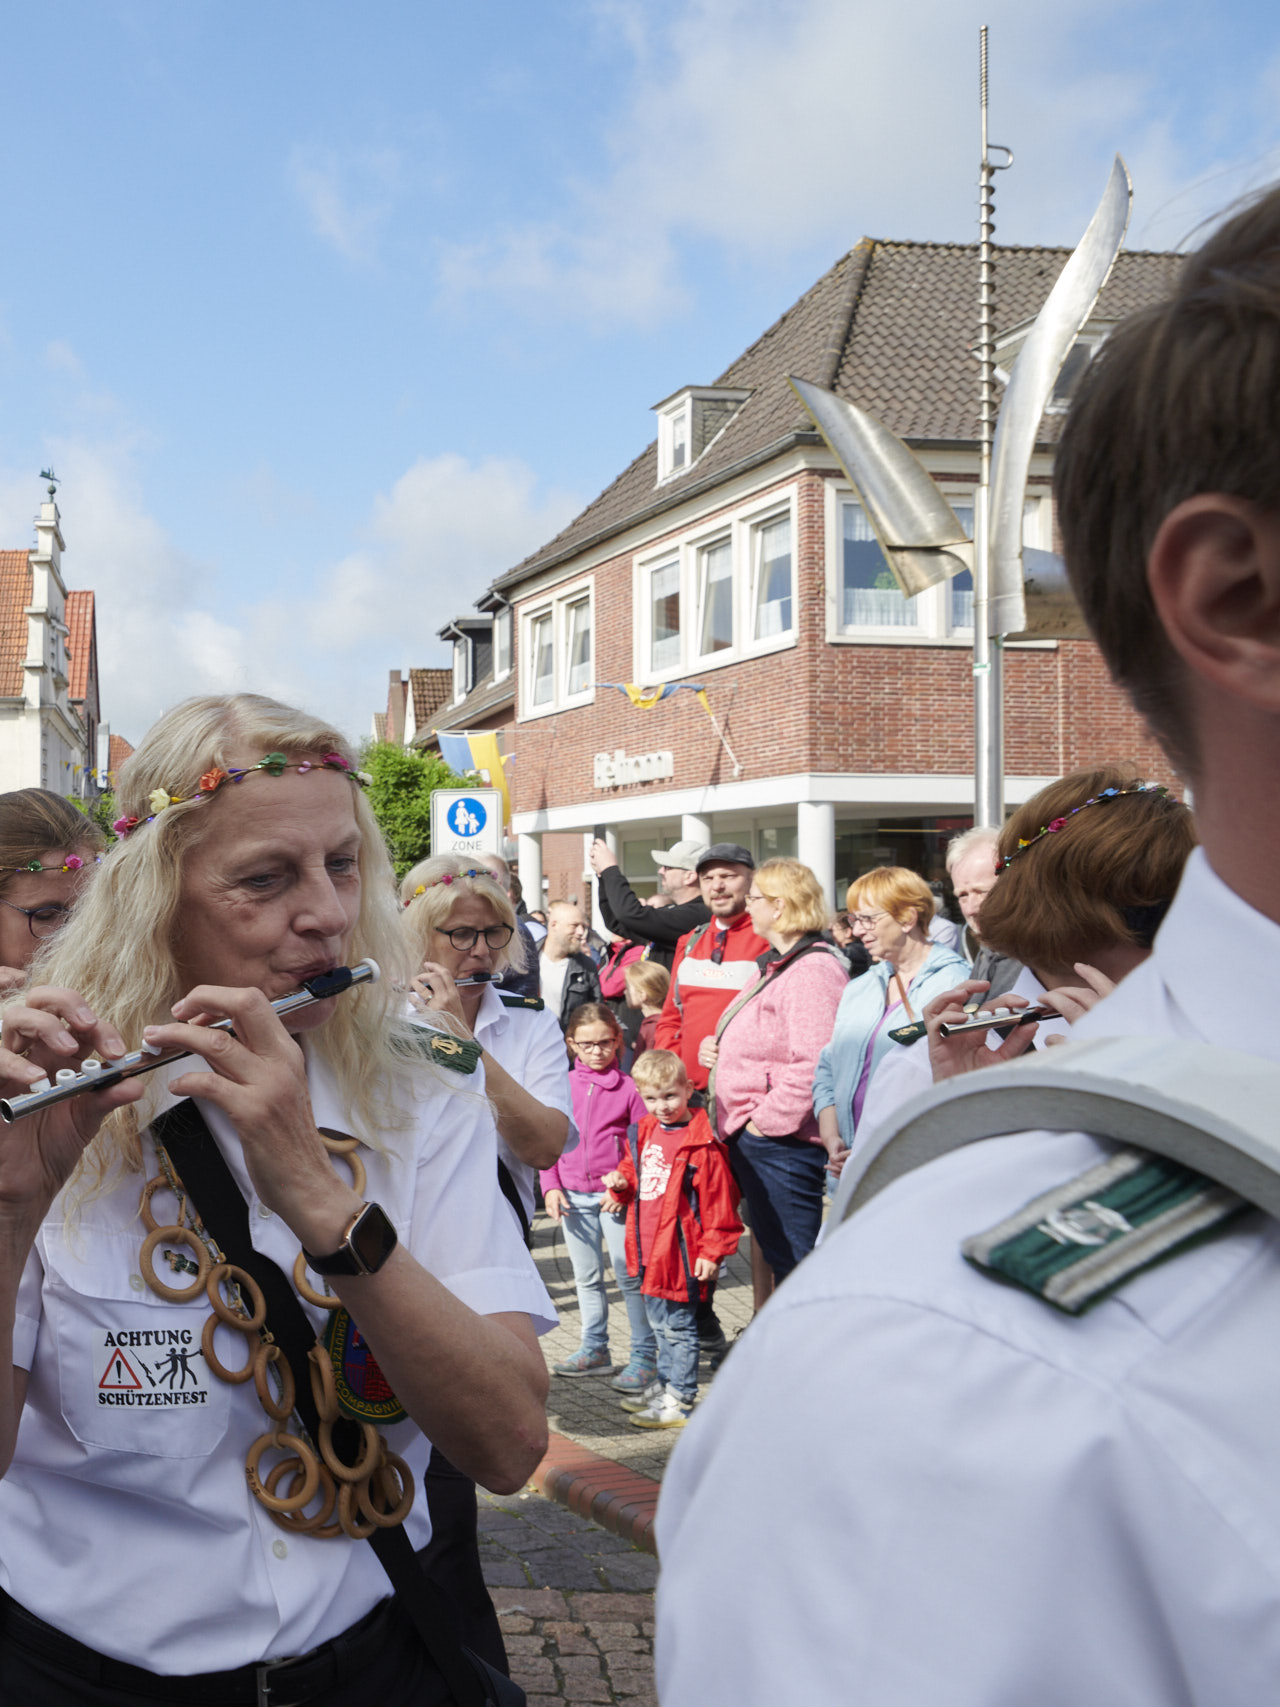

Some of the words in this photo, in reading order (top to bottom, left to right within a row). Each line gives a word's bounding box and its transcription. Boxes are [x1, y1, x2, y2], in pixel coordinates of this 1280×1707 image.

[451, 840, 482, 851] ZONE
[104, 1329, 193, 1347] ACHTUNG
[98, 1389, 208, 1406] SCHÜTZENFEST
